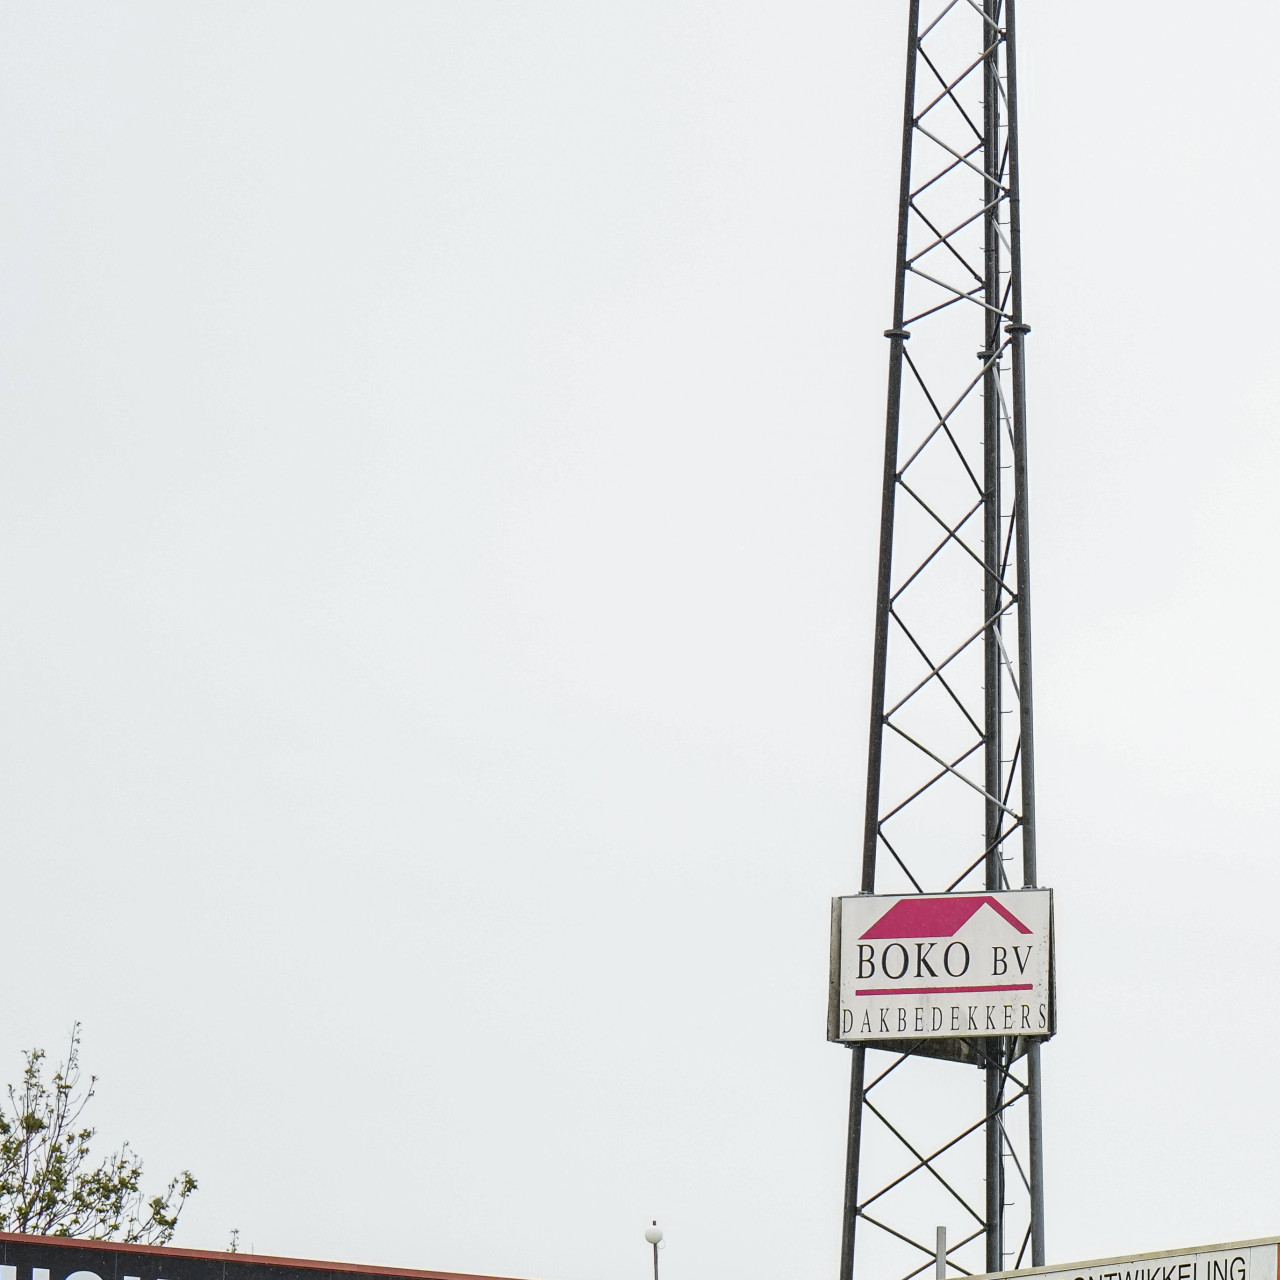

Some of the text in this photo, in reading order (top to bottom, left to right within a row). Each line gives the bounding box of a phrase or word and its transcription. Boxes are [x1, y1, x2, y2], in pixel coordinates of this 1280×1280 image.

[856, 941, 1033, 980] BOKO BV
[842, 1003, 1047, 1034] DAKBEDEKKERS
